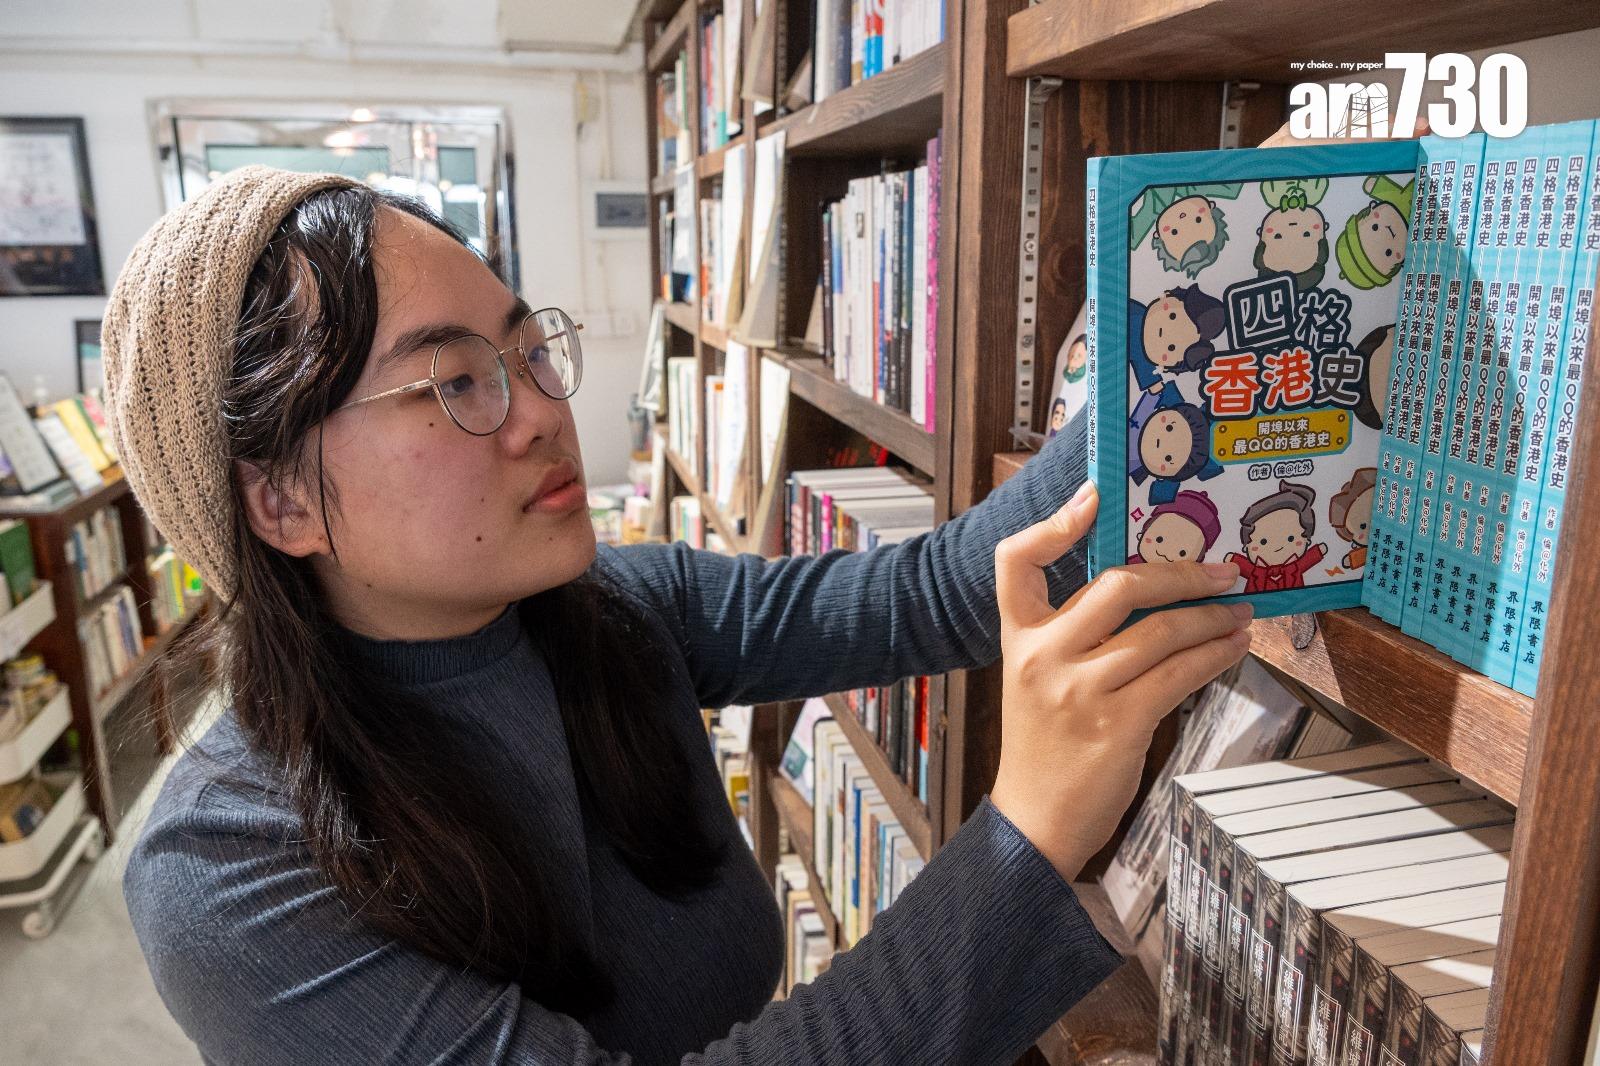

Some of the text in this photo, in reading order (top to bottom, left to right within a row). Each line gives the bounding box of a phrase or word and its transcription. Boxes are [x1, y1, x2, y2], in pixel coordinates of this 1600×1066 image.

[1422, 162, 1442, 242] 四格香港史
[1436, 160, 1456, 242] 四格香港史
[1455, 164, 1476, 246] 四格香港史
[1478, 162, 1500, 246] 四格香港史
[1496, 160, 1518, 247] 四格香港史
[1514, 158, 1537, 247] 四格香港史
[1536, 158, 1560, 248] 四格香港史
[1558, 156, 1584, 249] 四格香港史
[1227, 275, 1347, 350] 四格
[1204, 345, 1363, 416] 香港史
[1396, 273, 1428, 440] 開埠以來最QQ的香港史
[1408, 274, 1441, 444] 開埠以來最QQ的香港史
[1428, 280, 1461, 454] 開埠以來最QQ的香港史
[1450, 280, 1484, 458] 開埠以來最QQ的香港史
[1466, 282, 1502, 464] 開埠以來最QQ的香港史
[1482, 282, 1520, 468] 開埠以來最QQ的香港史
[1503, 285, 1542, 476] 開埠以來最QQ的香港史
[1524, 286, 1565, 482] 開埠以來最QQ的香港史
[1549, 289, 1592, 488] 開埠以來最QQ的香港史
[1232, 432, 1331, 455] 最QQ的香港史
[1257, 417, 1310, 436] 開埠以來
[1250, 466, 1269, 479] 作者
[1394, 456, 1402, 474] 作者
[1406, 460, 1414, 479] 作者
[1425, 472, 1434, 490] 作者
[1446, 474, 1456, 494] 作者
[1462, 481, 1472, 501] 作者
[1480, 486, 1489, 506] 作者
[1500, 492, 1510, 514] 作者
[1520, 500, 1532, 522] 作者
[1546, 507, 1557, 530] 作者
[1377, 534, 1393, 588] 界限書店
[1389, 540, 1405, 595] 界限書店
[1408, 552, 1426, 608] 界限書店
[1428, 558, 1446, 616] 界限書店
[1444, 566, 1462, 624] 界限書店
[1460, 573, 1478, 633] 界限書店
[1480, 582, 1498, 643] 界限書店
[1499, 591, 1520, 654] 界限書店
[1523, 600, 1544, 664] 界限書店
